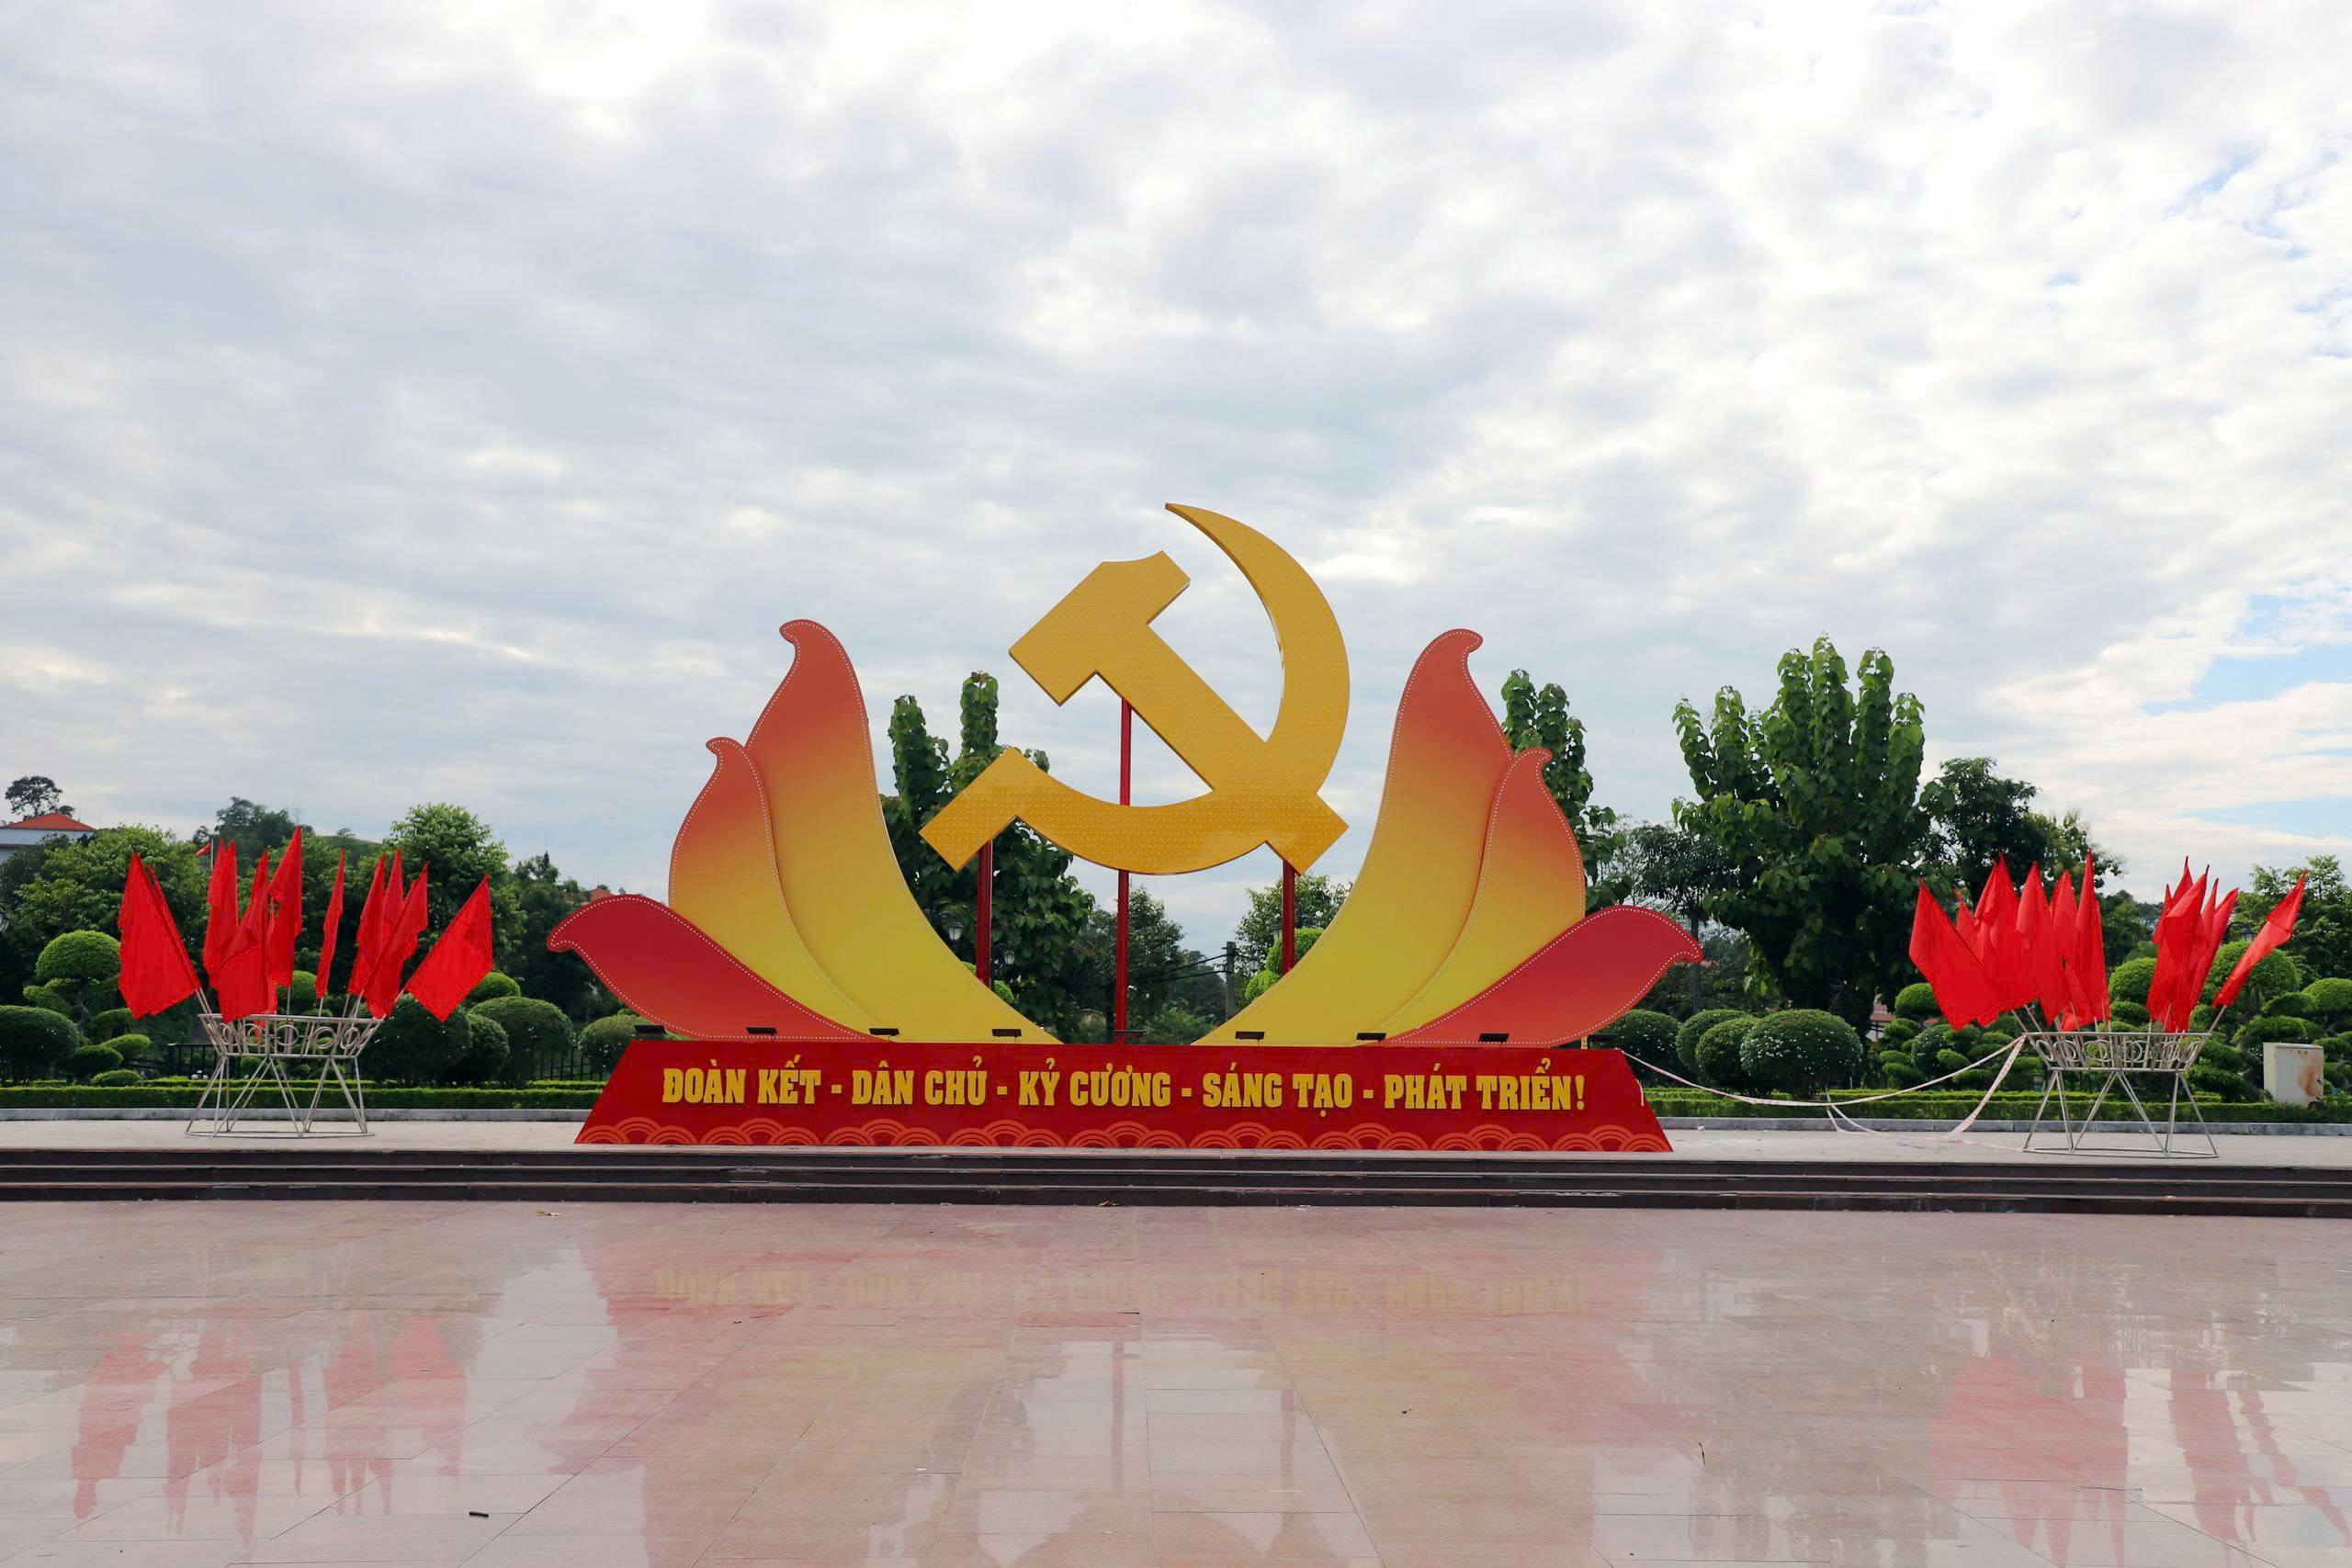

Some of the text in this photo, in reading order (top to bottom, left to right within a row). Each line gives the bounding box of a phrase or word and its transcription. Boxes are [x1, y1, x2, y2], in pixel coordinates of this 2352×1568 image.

[662, 1059, 747, 1104] ĐOÀN
[757, 1055, 821, 1104] KẾT
[852, 1060, 915, 1105] DÂN
[924, 1055, 988, 1106] CHỦ
[1018, 1057, 1060, 1106] KỶ
[1069, 1062, 1170, 1108] CƯƠNG
[1202, 1062, 1283, 1108] SÁNG
[1292, 1072, 1352, 1118] TẠO
[1384, 1063, 1467, 1110] PHÁT
[1476, 1057, 1586, 1111] TRIỂN!
